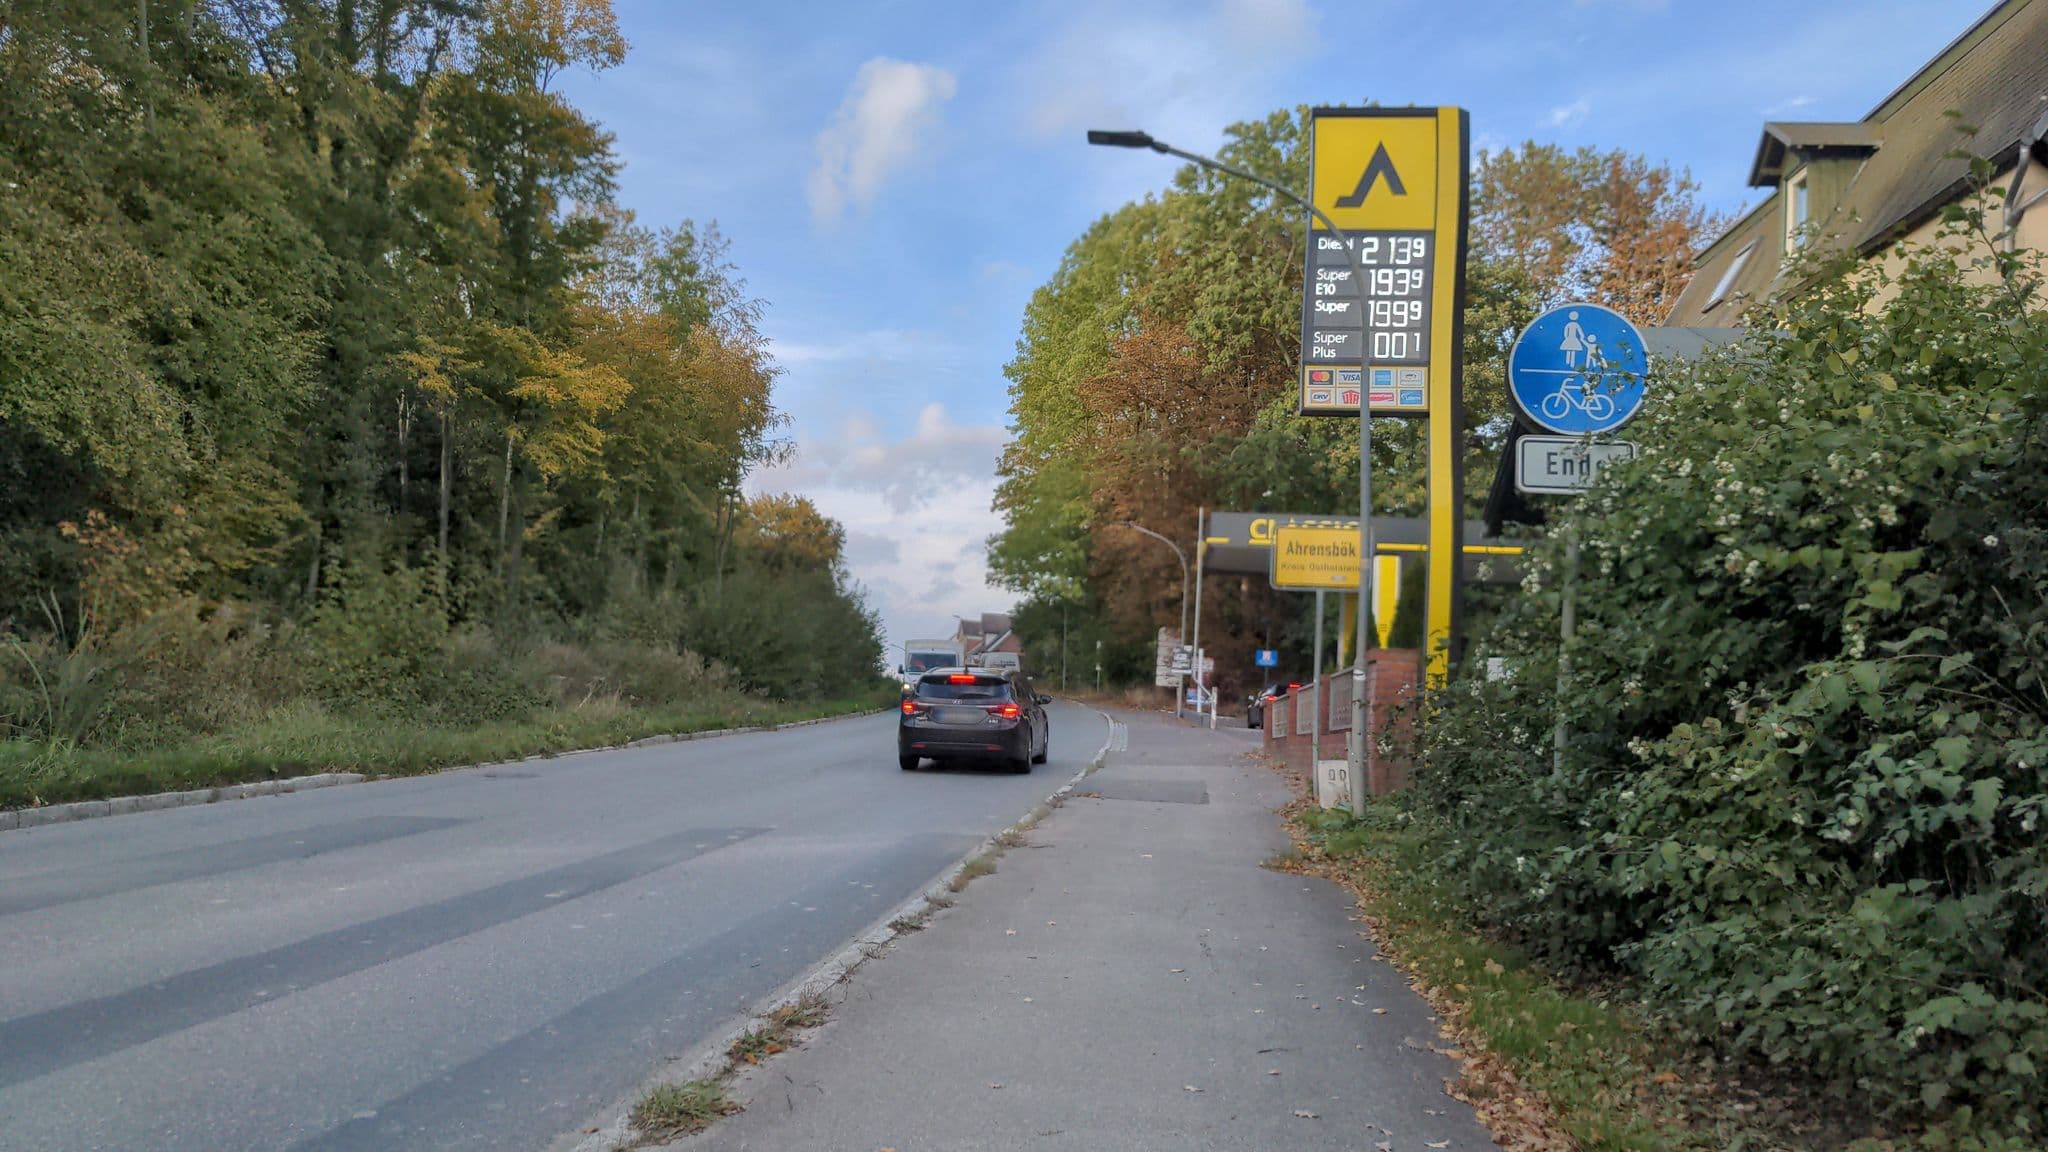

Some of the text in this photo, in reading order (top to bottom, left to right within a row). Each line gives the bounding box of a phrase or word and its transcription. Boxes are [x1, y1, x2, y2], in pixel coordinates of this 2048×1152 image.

[1318, 237, 1355, 250] Diesl
[1316, 268, 1352, 282] Super
[1369, 268, 1424, 296] 1939
[1315, 283, 1336, 295] E10
[1315, 299, 1422, 327] Super 1999
[1313, 331, 1348, 346] Super
[1312, 346, 1336, 358] Plus
[1341, 374, 1361, 382] VISA
[1546, 451, 1606, 476] End
[1286, 540, 1356, 557] Ahrensbök
